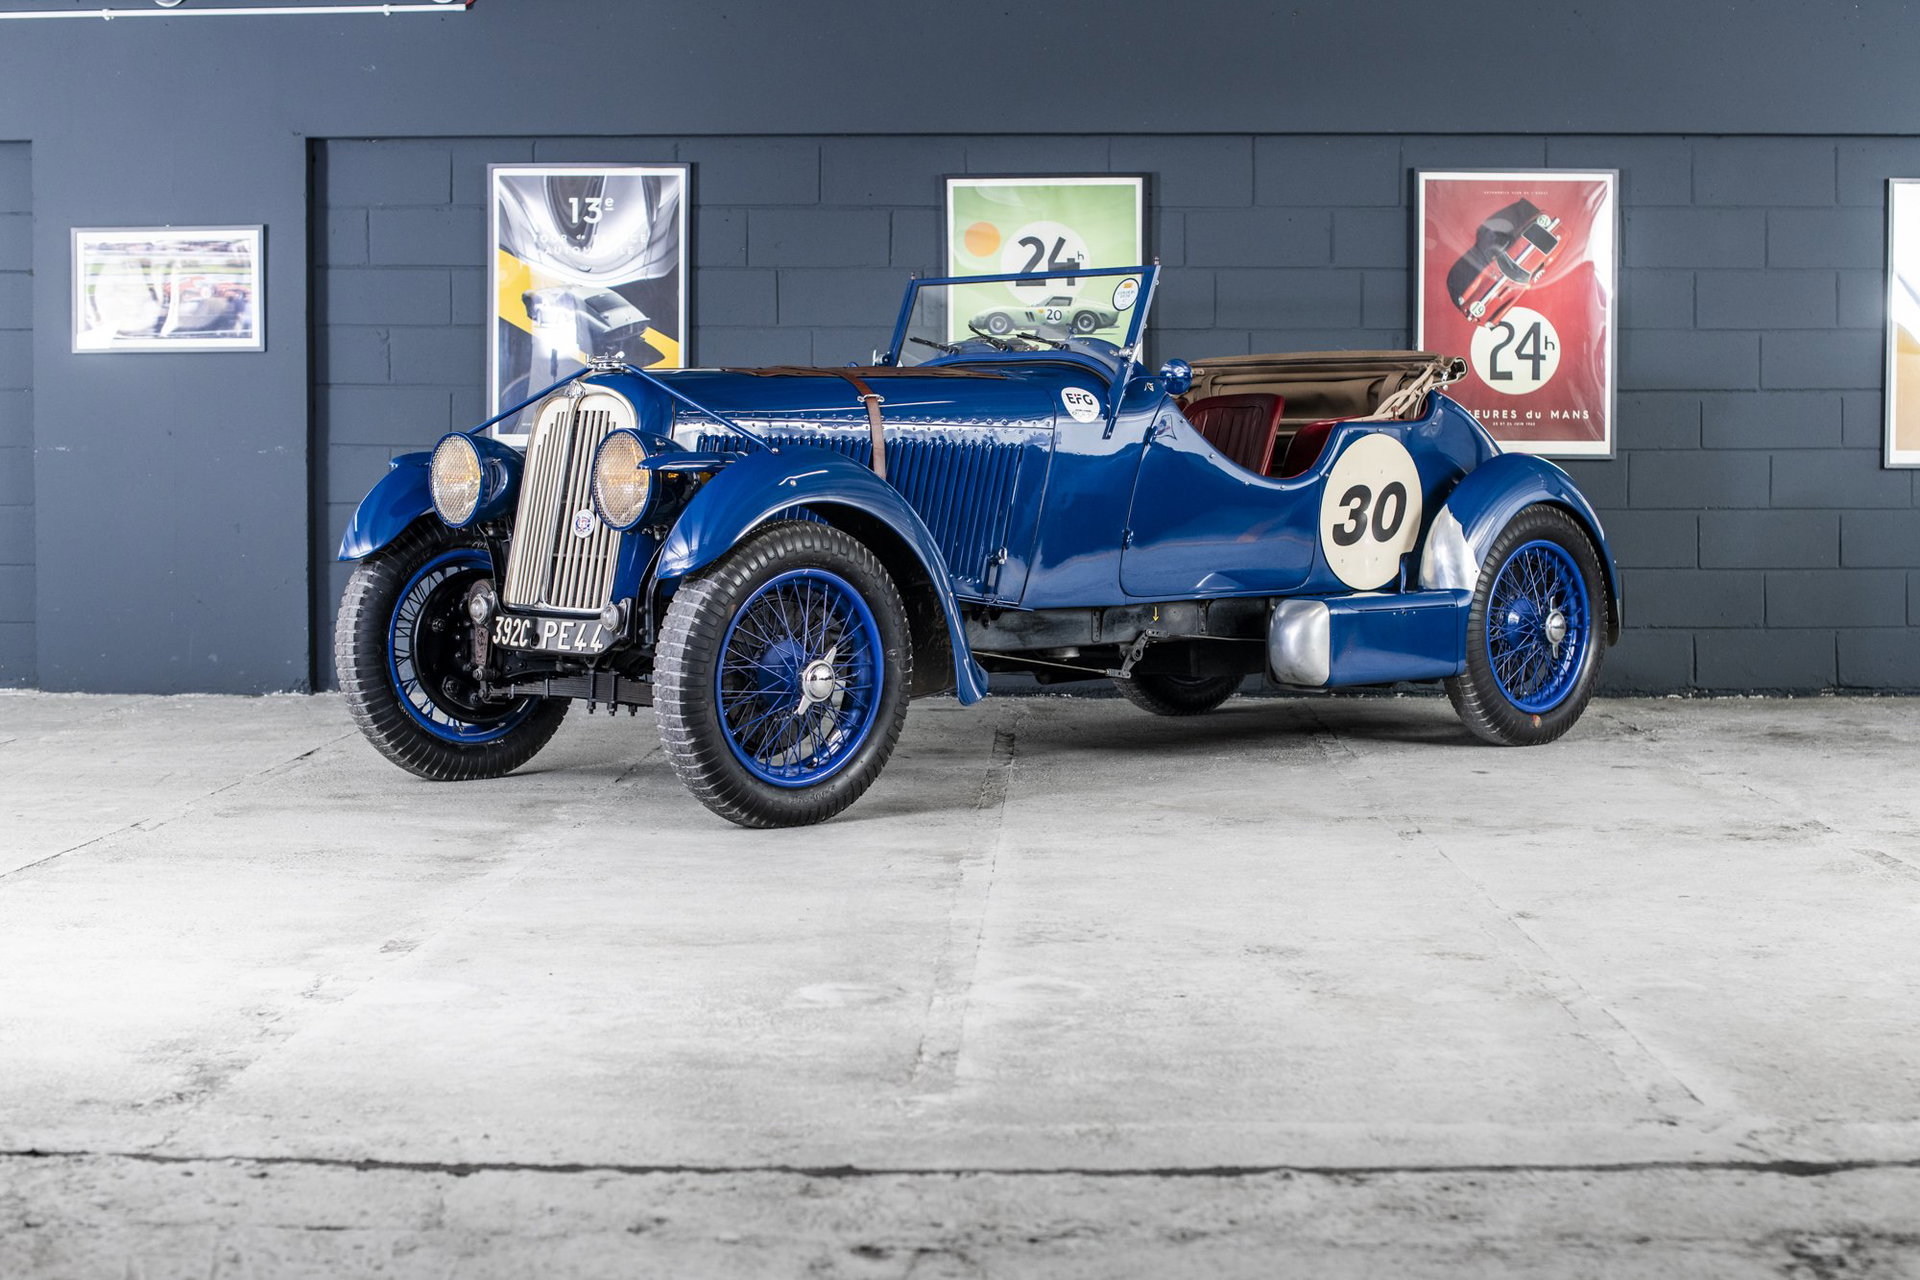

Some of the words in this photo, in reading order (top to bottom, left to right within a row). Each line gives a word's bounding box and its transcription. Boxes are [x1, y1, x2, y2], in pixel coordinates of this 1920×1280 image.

[1046, 309, 1062, 321] 20
[1065, 393, 1093, 405] EFG
[1525, 409, 1542, 419] du
[1550, 409, 1590, 420] MANS
[1332, 481, 1408, 546] 30
